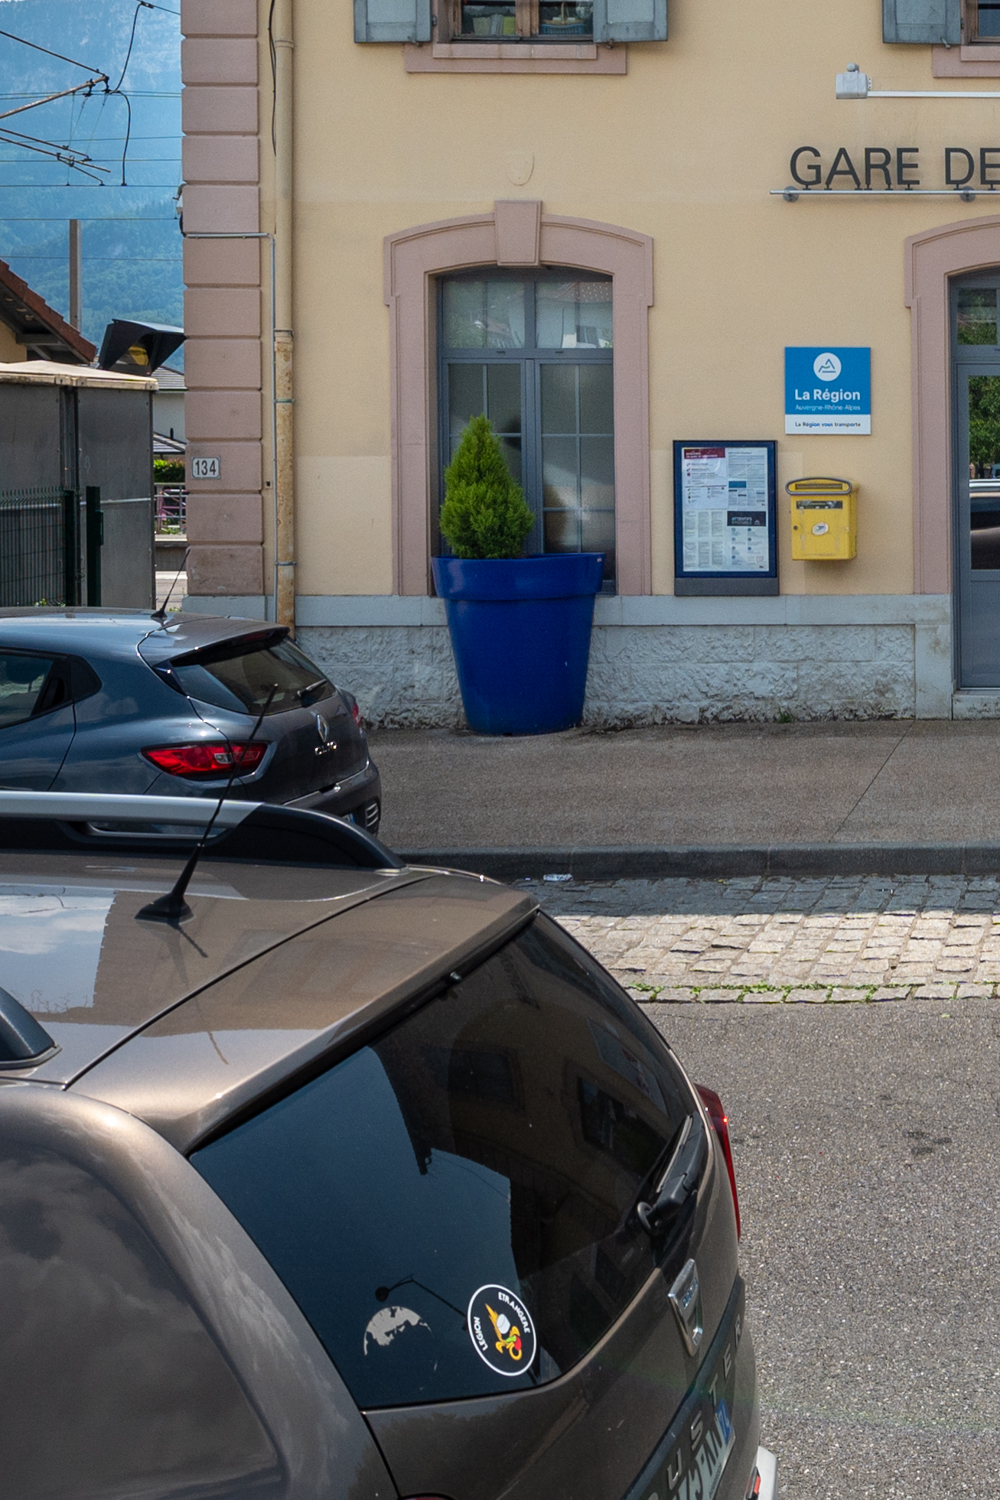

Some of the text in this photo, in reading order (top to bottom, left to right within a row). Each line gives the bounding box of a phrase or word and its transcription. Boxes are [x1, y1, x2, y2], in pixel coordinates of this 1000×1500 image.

[789, 146, 920, 188] GARE
[794, 388, 861, 403] La Région
[803, 421, 820, 429] Région
[835, 421, 861, 429] transporte
[194, 459, 217, 476] 134
[473, 1291, 531, 1351] LEGION ETRANGERE
[647, 1313, 742, 1500] USTER
